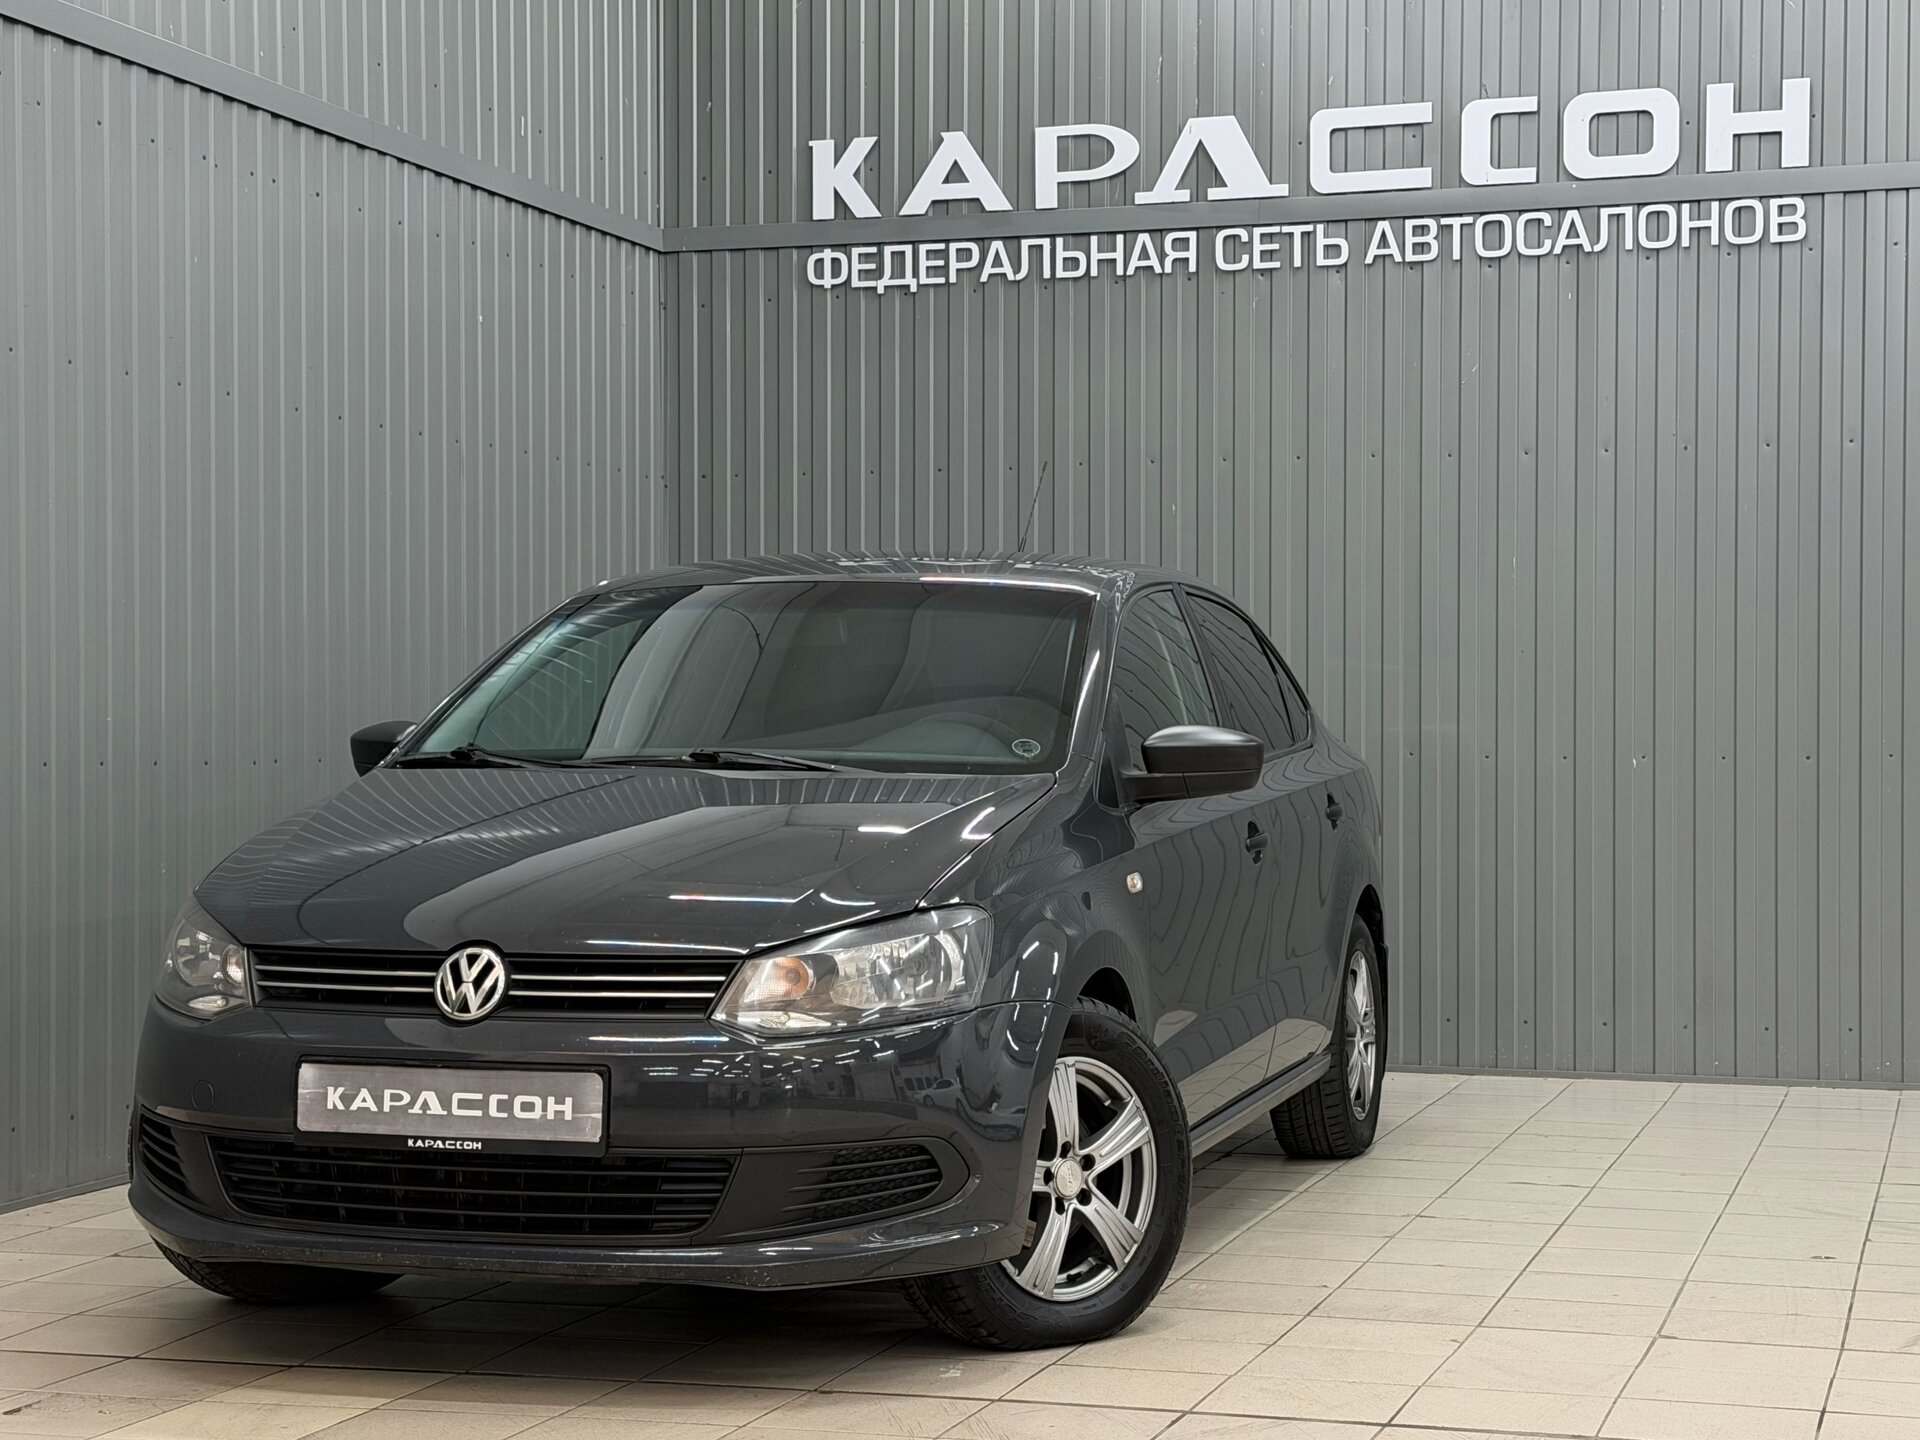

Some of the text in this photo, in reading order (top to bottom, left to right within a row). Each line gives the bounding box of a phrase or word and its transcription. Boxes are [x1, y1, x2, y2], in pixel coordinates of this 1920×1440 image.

[809, 77, 1811, 220] КАРЛССОН
[806, 197, 1807, 294] ФЕДЕРАЛЬНАЯ СЕТЬ АВТОСАЛОНОВ
